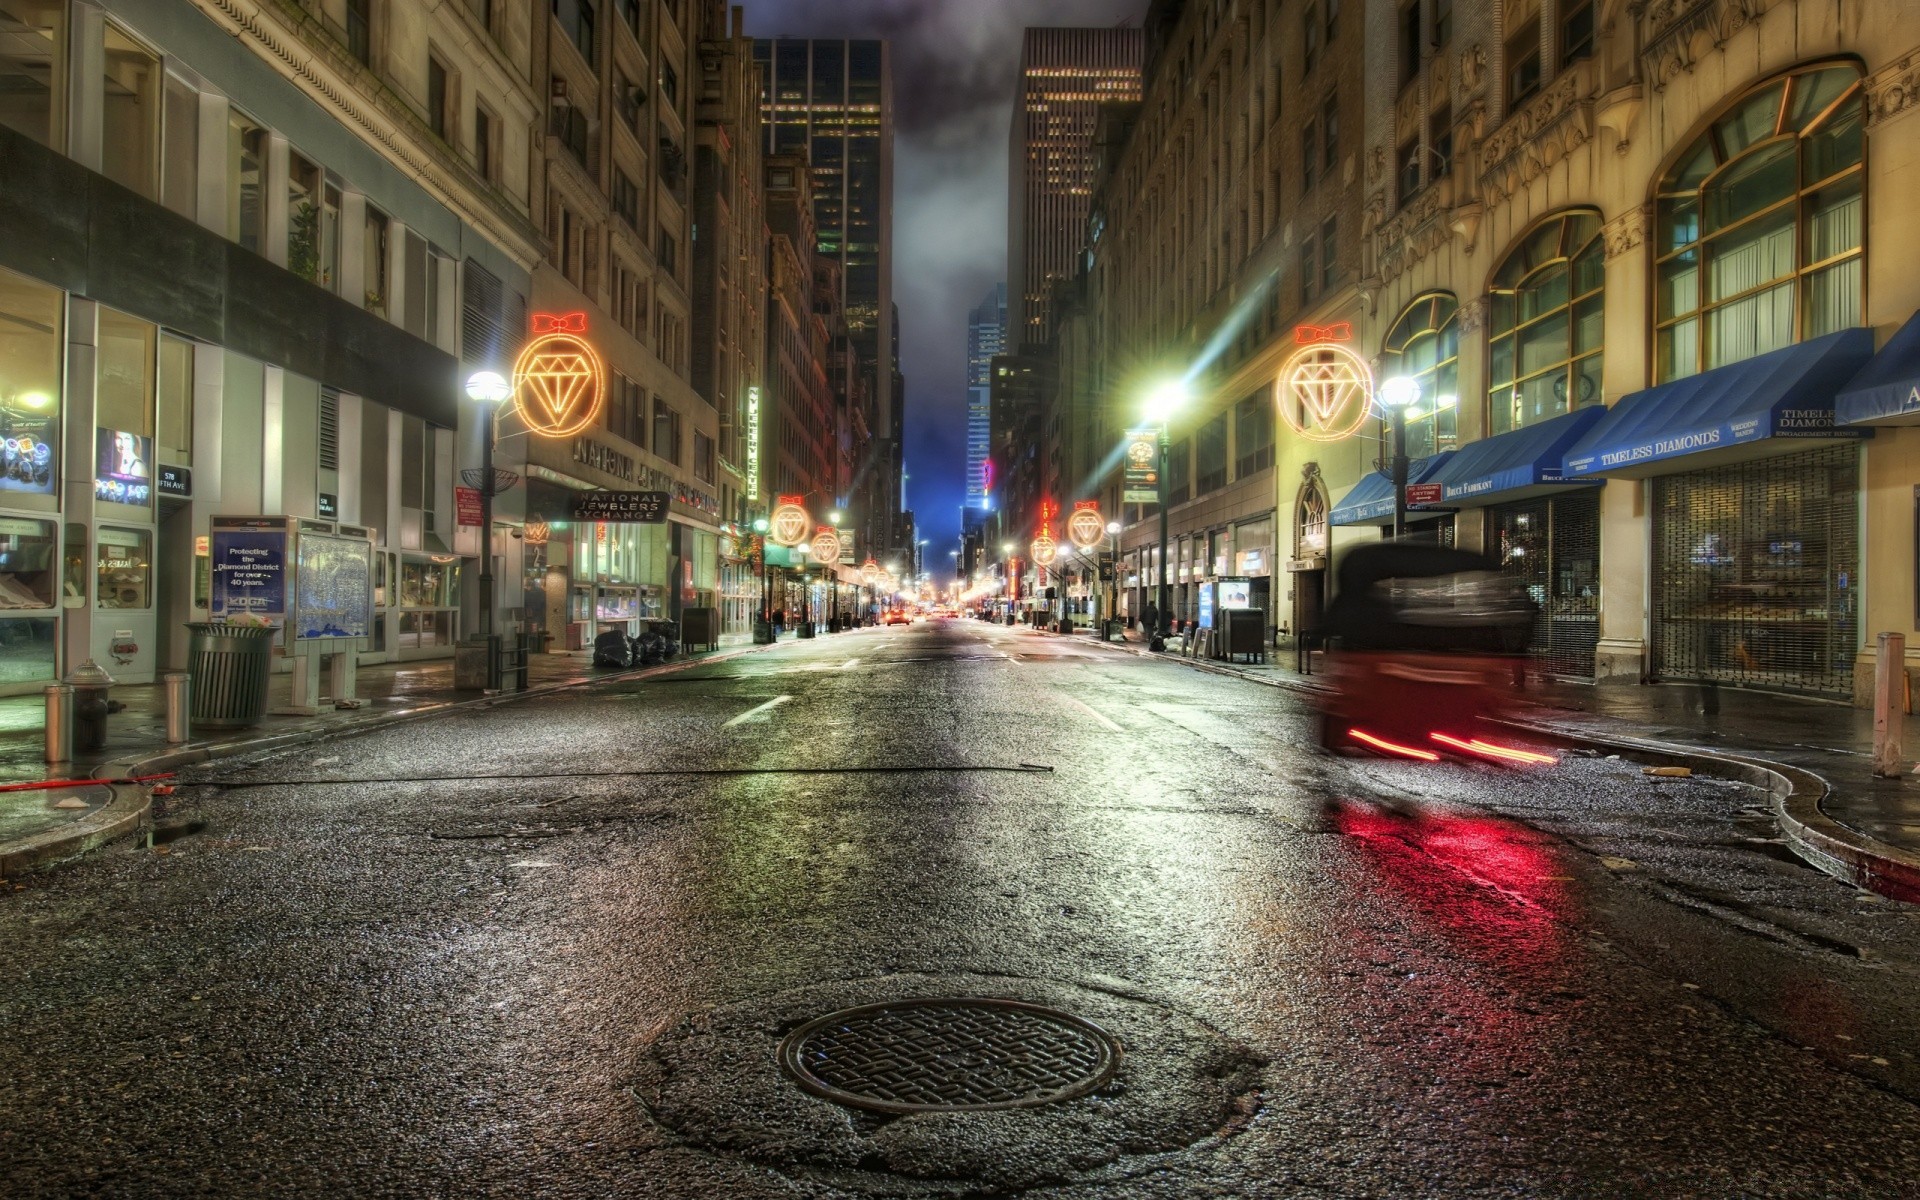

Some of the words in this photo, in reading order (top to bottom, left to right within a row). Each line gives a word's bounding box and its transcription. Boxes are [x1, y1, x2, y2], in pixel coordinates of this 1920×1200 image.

[1907, 386, 1920, 404] A
[1782, 409, 1836, 418] TIMELE
[1779, 418, 1836, 428] DIAMON
[748, 409, 758, 453] JEWELRY
[1601, 446, 1652, 466] TIMELESS
[1655, 430, 1720, 455] DIAMONDS
[164, 472, 175, 480] 578
[747, 458, 757, 496] CENTER
[580, 493, 661, 503] NATIONAL
[579, 503, 659, 511] JEWELERS
[574, 510, 655, 520] EXCHANGE
[229, 548, 269, 556] Protecting
[218, 563, 251, 571] Diamond
[252, 563, 279, 571] District
